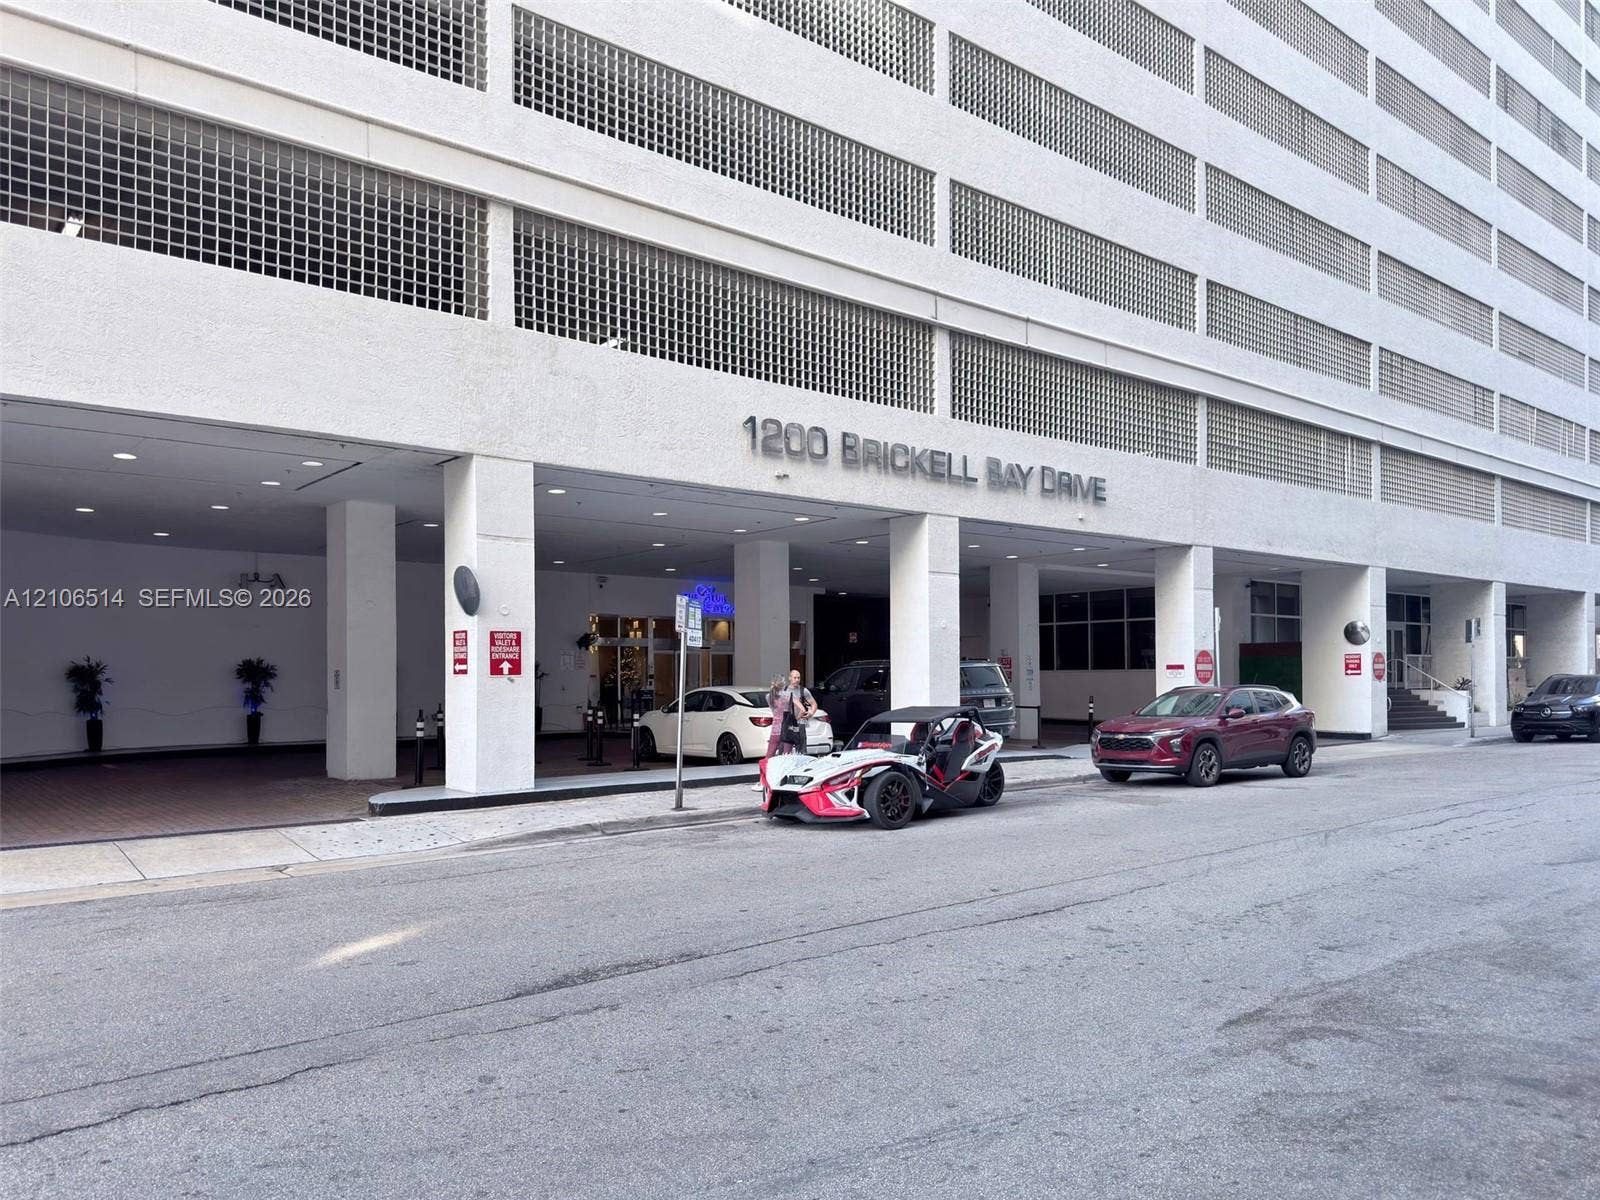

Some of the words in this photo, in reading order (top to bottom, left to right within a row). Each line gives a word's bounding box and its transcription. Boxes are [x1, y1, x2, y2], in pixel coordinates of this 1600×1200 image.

[743, 415, 829, 460] 1200
[841, 431, 978, 483] BRICKELL
[986, 456, 1034, 491] BAY
[1040, 465, 1107, 502] DRIVE
